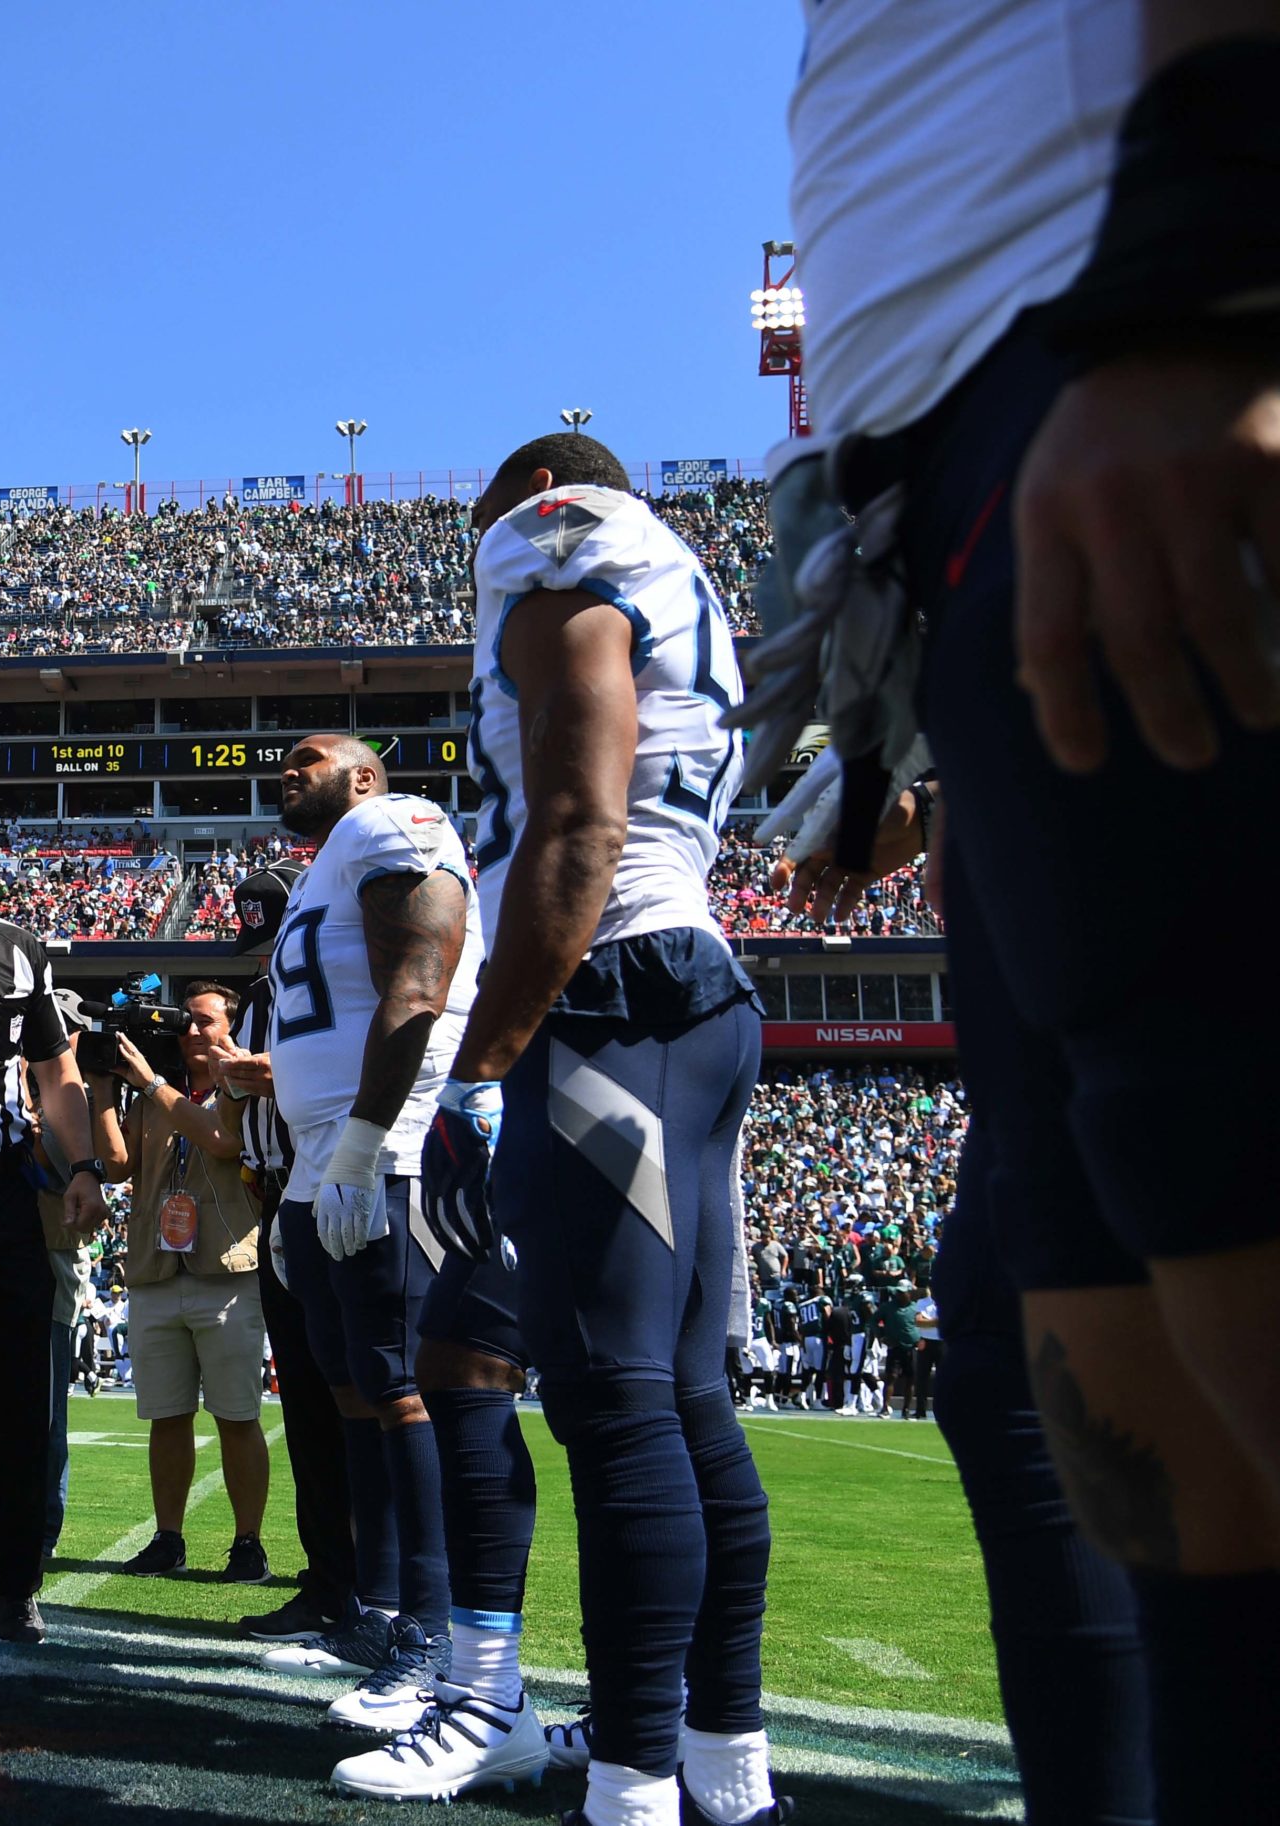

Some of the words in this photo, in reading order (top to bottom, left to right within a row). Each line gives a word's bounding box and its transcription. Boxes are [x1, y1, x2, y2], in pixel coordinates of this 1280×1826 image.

[678, 461, 710, 472] EDDIE
[258, 477, 289, 488] EARL
[663, 471, 725, 484] GEORGE
[9, 488, 48, 499] GEORGE
[244, 487, 303, 500] CAMPBELL
[52, 745, 73, 758] 1st
[76, 744, 103, 758] and
[107, 744, 124, 757] 10
[192, 744, 246, 767] 1:25
[256, 748, 284, 762] 1ST
[442, 741, 456, 761] 0
[56, 762, 82, 773] BALL
[84, 762, 99, 772] ON
[105, 761, 120, 772] 35
[267, 903, 337, 1046] 9
[816, 1028, 902, 1042] NISSAN
